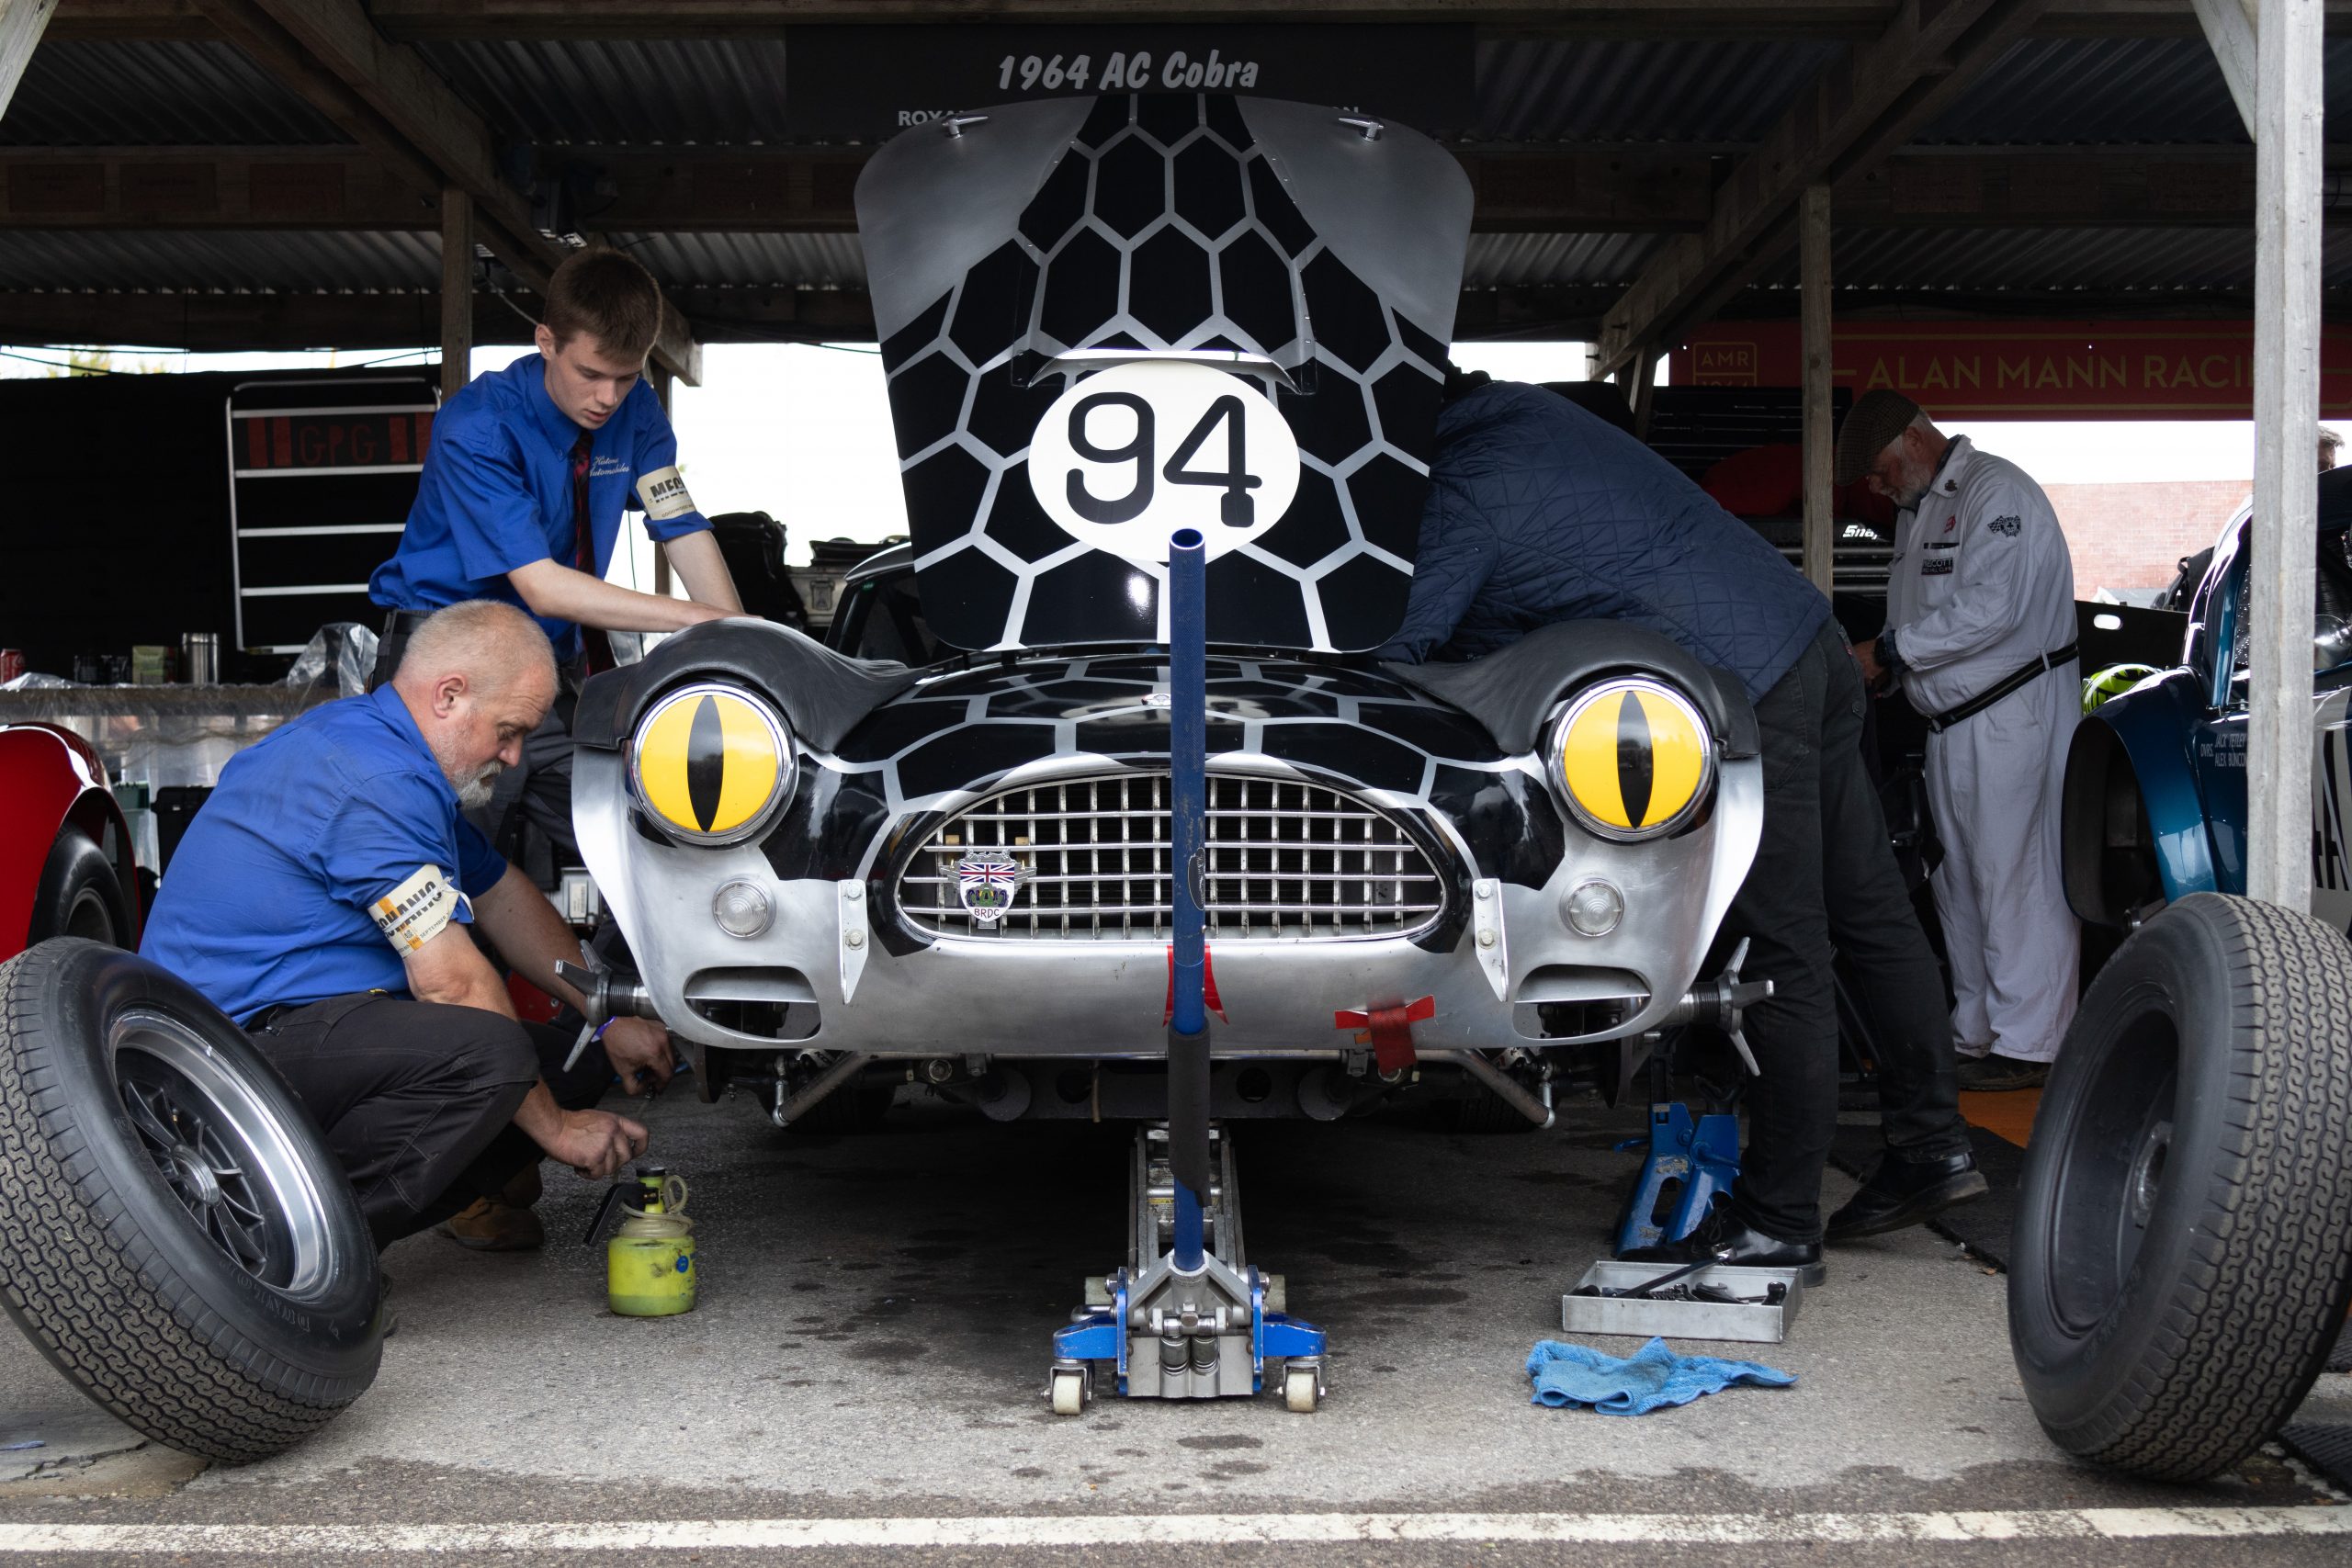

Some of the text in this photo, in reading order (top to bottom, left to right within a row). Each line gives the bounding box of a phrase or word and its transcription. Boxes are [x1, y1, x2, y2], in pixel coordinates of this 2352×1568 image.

[1000, 49, 1260, 90] 1964 AC Cobra
[1701, 350, 1749, 367] AMR
[1866, 354, 2255, 389] ALAN MANN RACI
[298, 423, 377, 467] GPG
[1066, 391, 1262, 528] 94
[650, 476, 687, 503] MEC
[376, 880, 443, 938] CHANIC
[974, 908, 1000, 919] BRDC
[420, 915, 447, 939] SEPTEMBER
